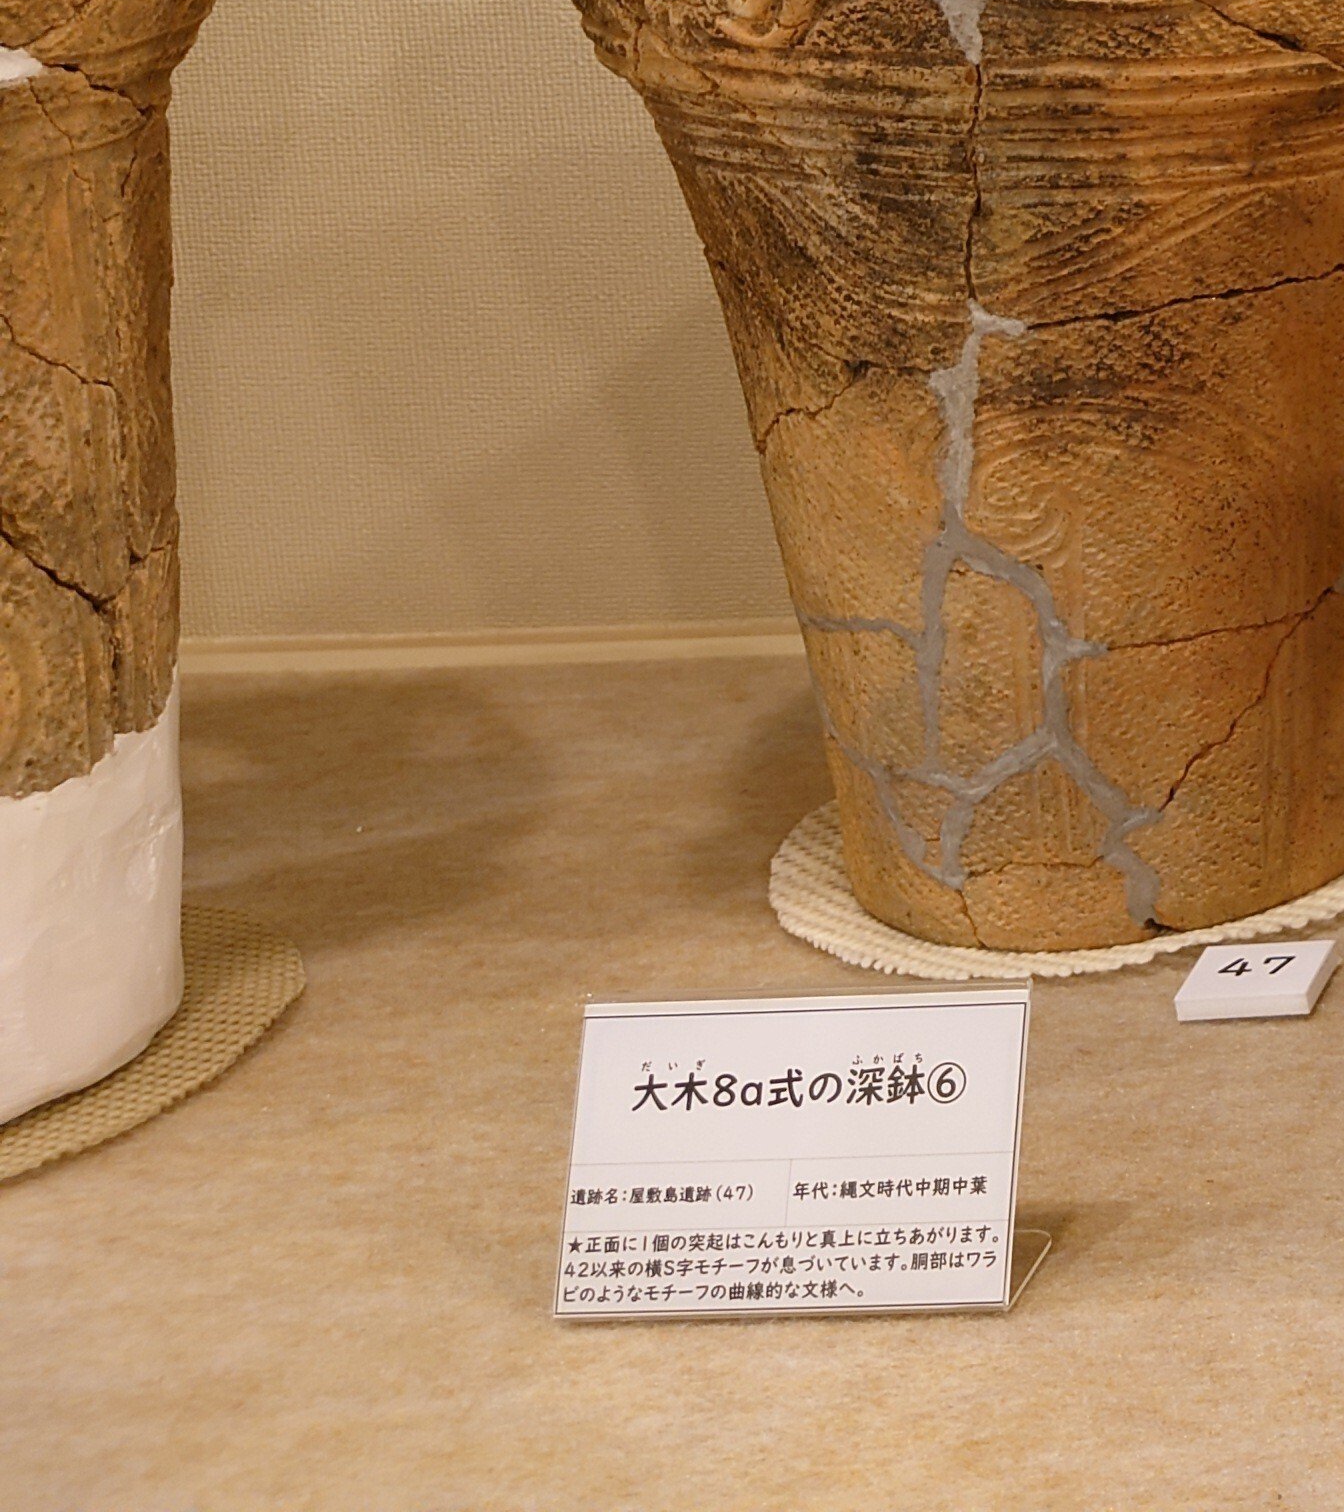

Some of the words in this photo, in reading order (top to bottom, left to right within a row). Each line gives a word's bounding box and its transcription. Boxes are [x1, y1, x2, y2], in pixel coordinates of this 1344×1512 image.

[1217, 955, 1296, 977] 47
[631, 1059, 968, 1113] 大木8a式の深鉢⑥
